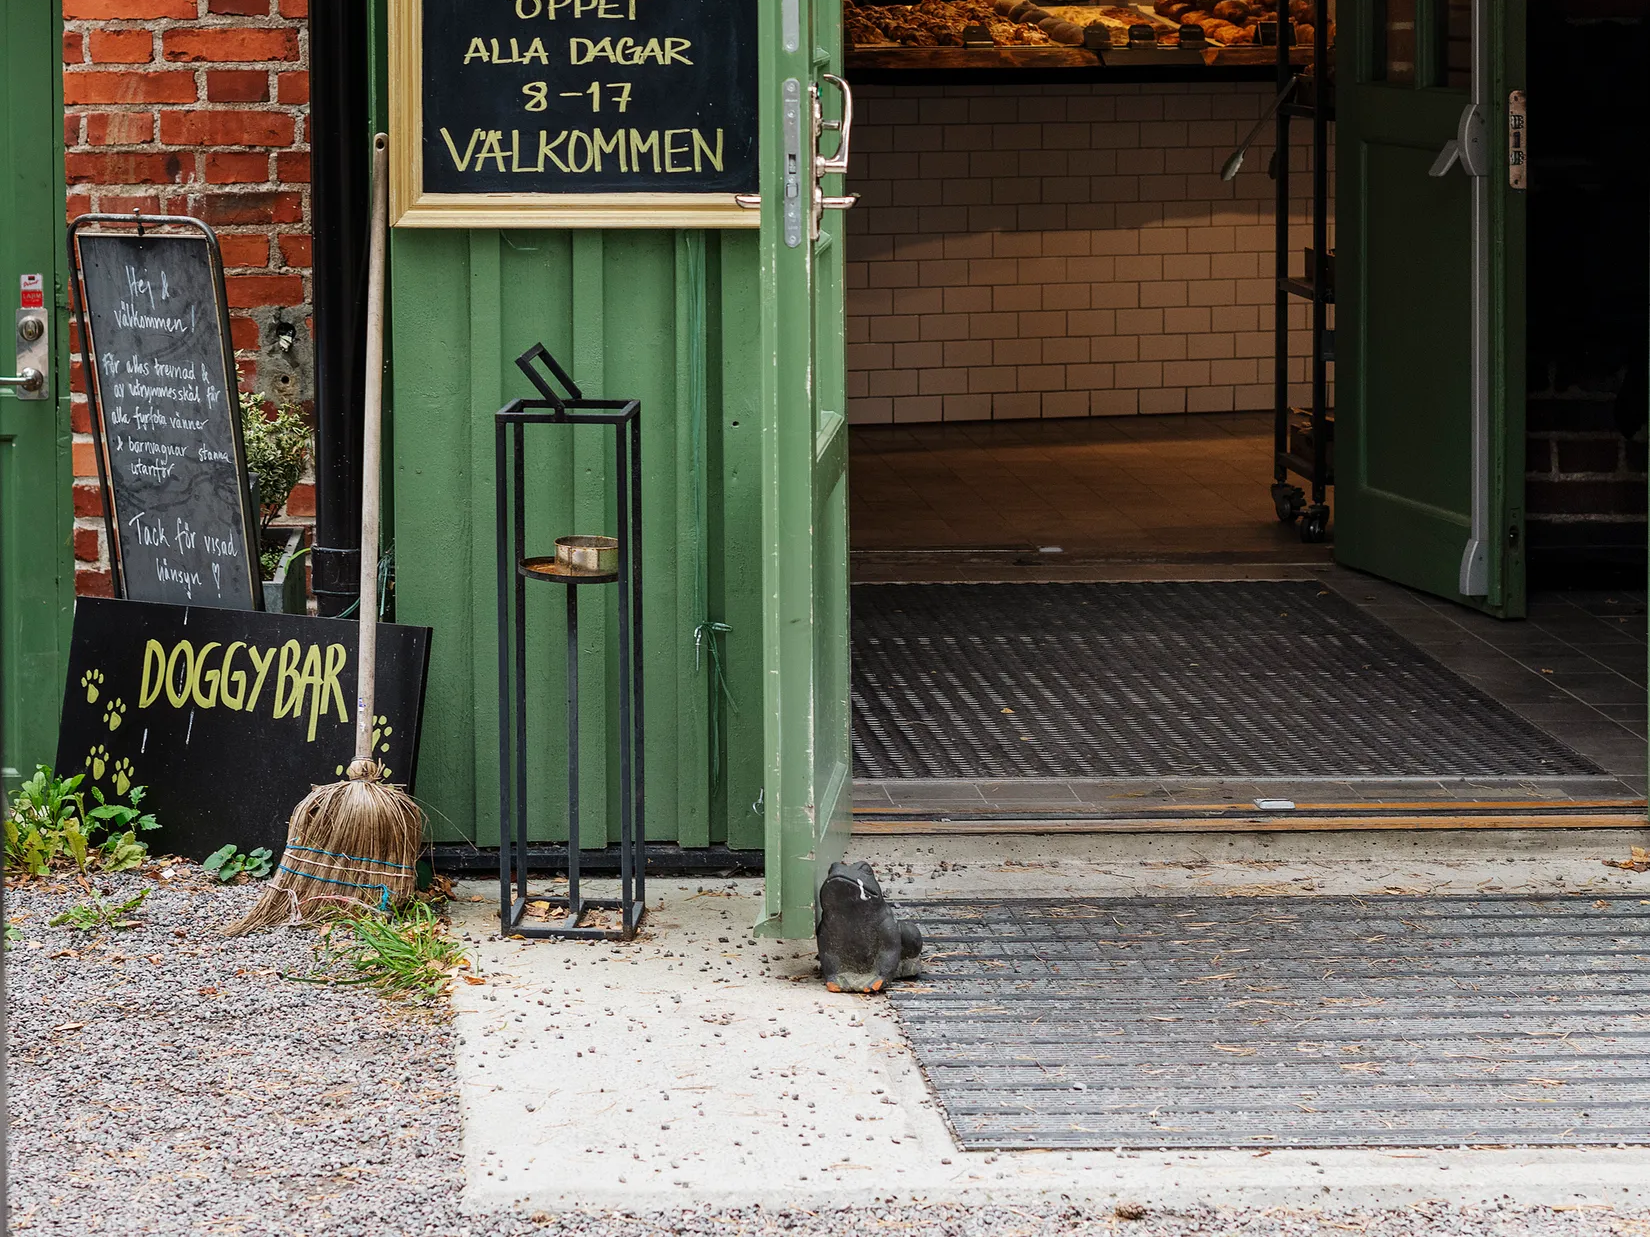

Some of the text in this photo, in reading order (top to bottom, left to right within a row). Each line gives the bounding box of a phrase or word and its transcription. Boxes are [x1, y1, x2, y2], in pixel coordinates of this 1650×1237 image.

[465, 38, 691, 64] ALLA DAGAR
[442, 128, 722, 172] VÄLKOMMEN
[125, 265, 155, 310] Hej
[112, 406, 130, 425] alla
[170, 413, 209, 430] vänner
[131, 458, 175, 482] utanför
[198, 443, 232, 464] stanna
[128, 512, 237, 557] Tack för visad
[156, 558, 202, 599] hänsyn
